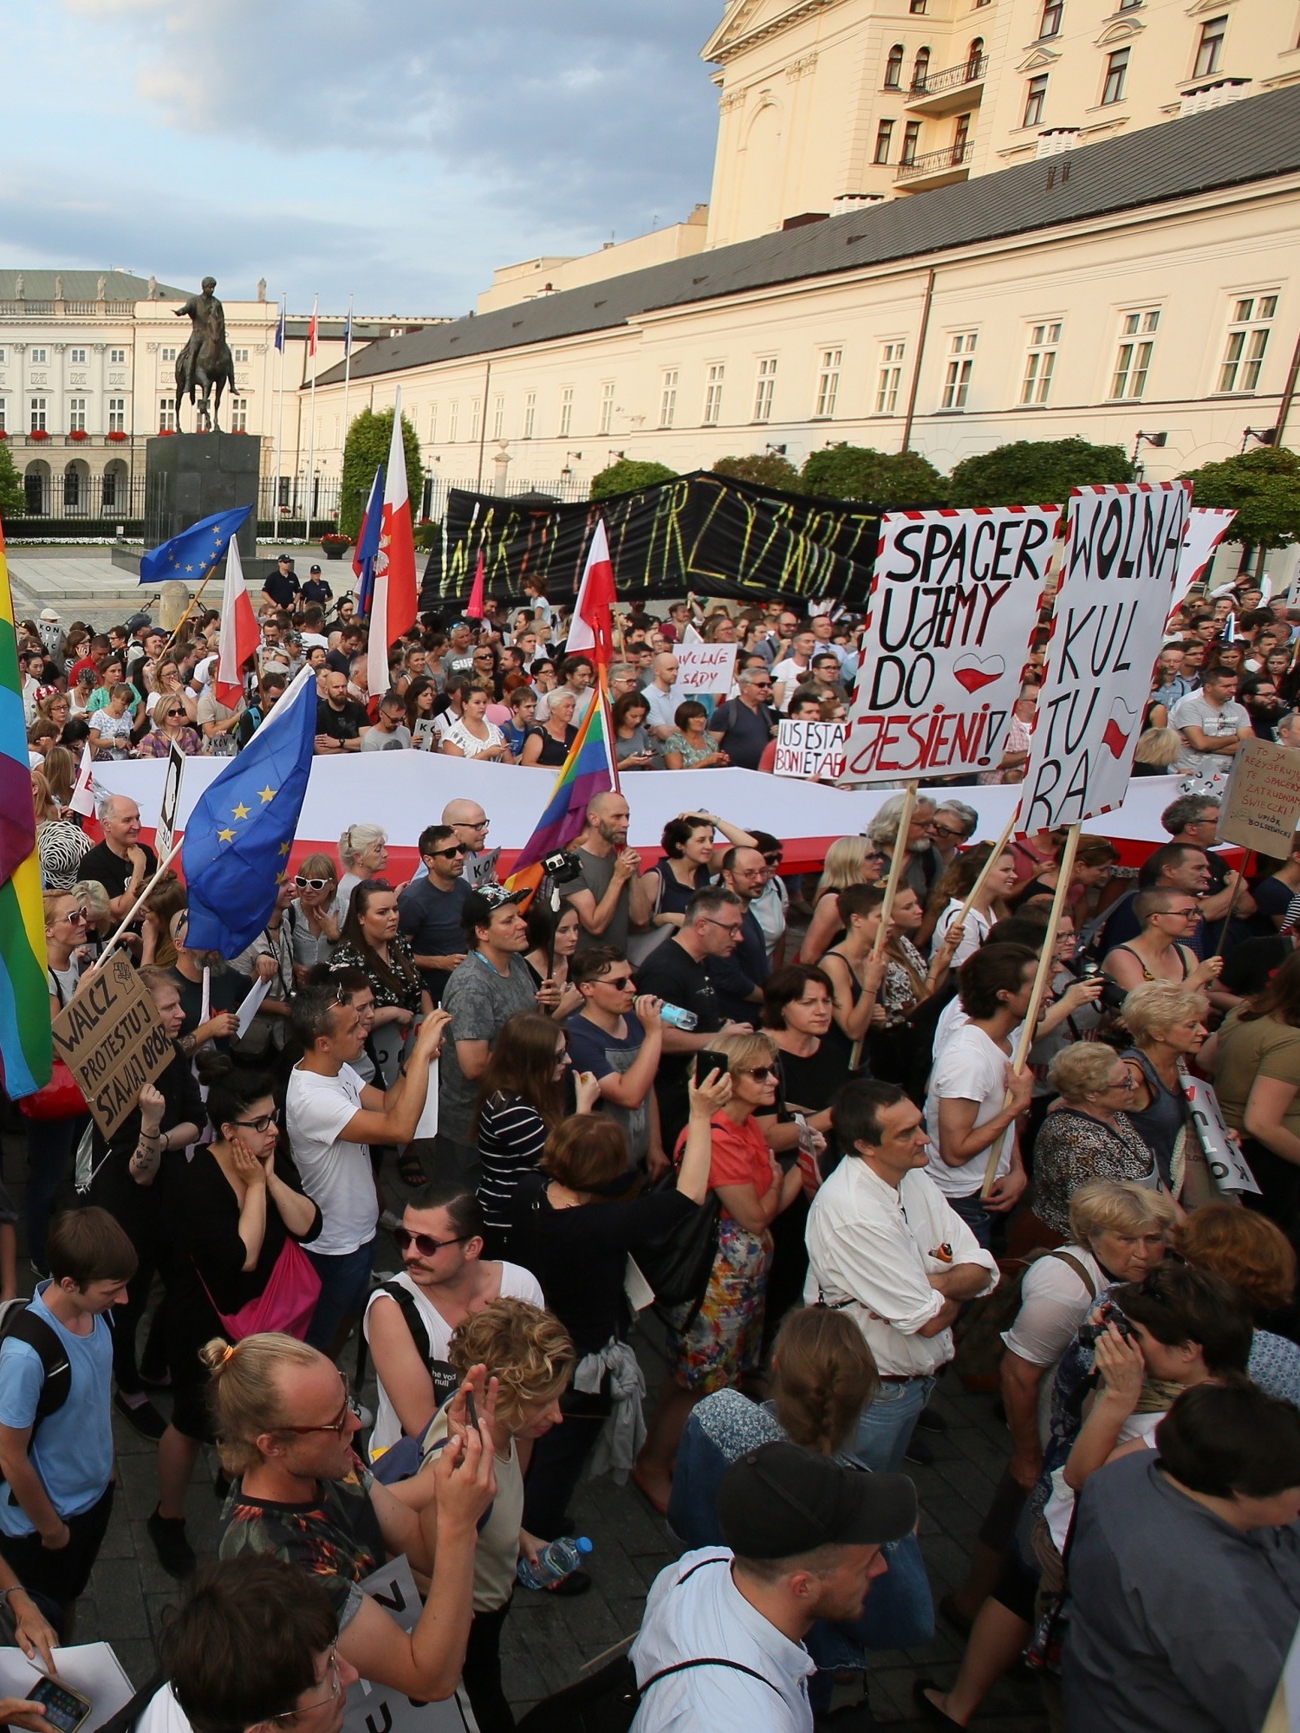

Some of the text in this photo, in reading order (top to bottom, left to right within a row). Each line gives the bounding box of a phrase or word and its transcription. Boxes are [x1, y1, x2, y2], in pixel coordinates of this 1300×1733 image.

[885, 518, 1049, 584] SPACER
[1069, 489, 1185, 580] WOLNA
[878, 582, 1011, 653] UJEMY
[1058, 600, 1139, 685] KUL
[678, 647, 729, 666] WOLNE
[868, 651, 936, 711] DO
[779, 721, 801, 747] IUS
[849, 702, 1007, 775] JESIENI!
[1044, 687, 1101, 760] TU
[1256, 747, 1286, 763] TO JA
[776, 748, 803, 772] BONI
[804, 751, 822, 775] ET
[1024, 747, 1092, 832] RA
[1246, 770, 1257, 780] TE
[51, 973, 119, 1053] WALCZ
[79, 999, 151, 1091] PROTESTUJ
[95, 1053, 148, 1127] STAWIAJ
[434, 1379, 449, 1388] null
